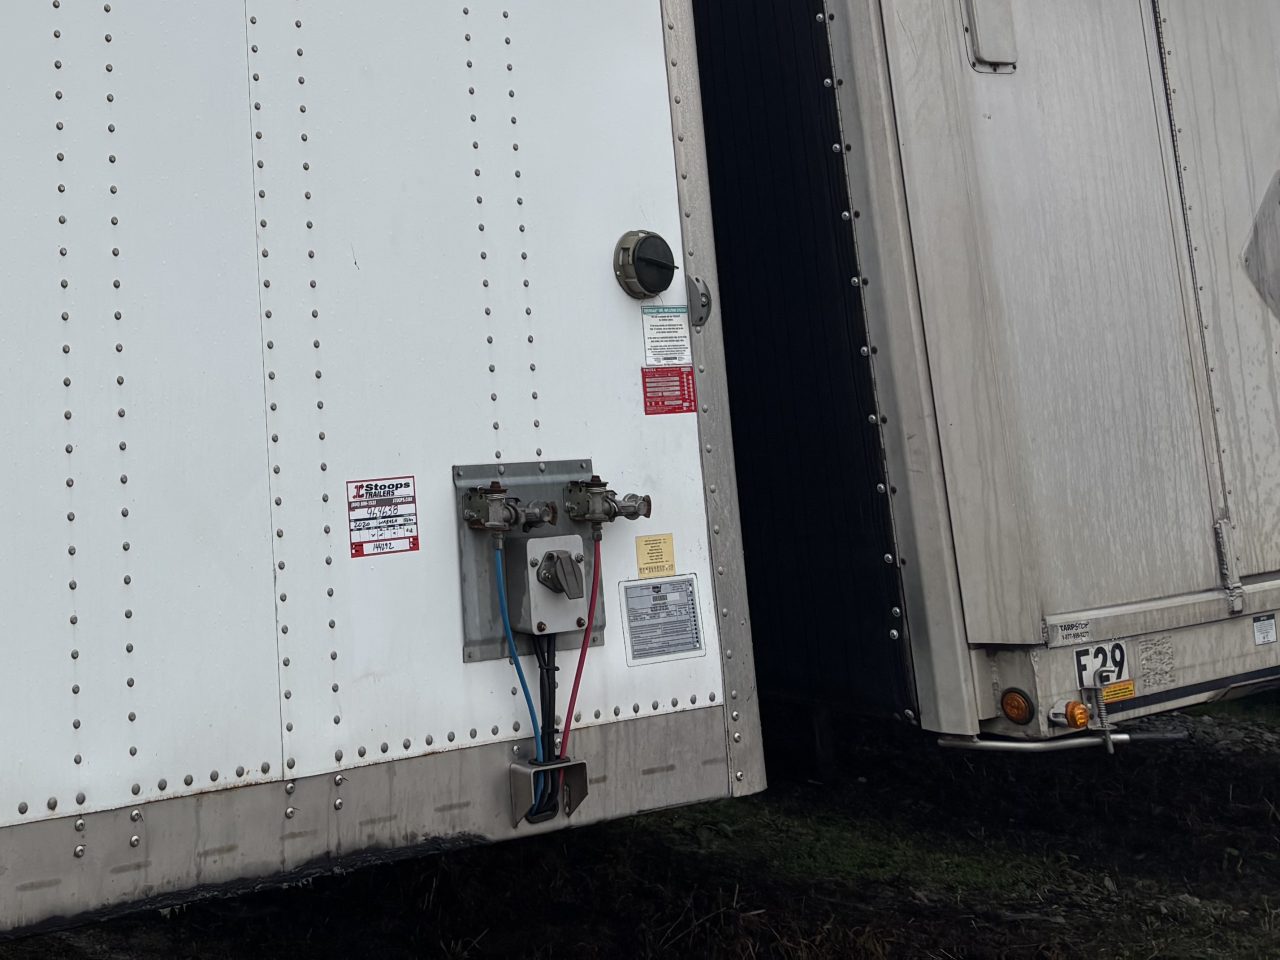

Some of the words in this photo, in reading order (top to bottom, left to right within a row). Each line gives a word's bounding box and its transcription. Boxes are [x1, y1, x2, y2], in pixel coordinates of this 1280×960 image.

[364, 482, 411, 492] Stoops
[364, 490, 395, 499] TRAILERS
[1075, 642, 1125, 689] F29
